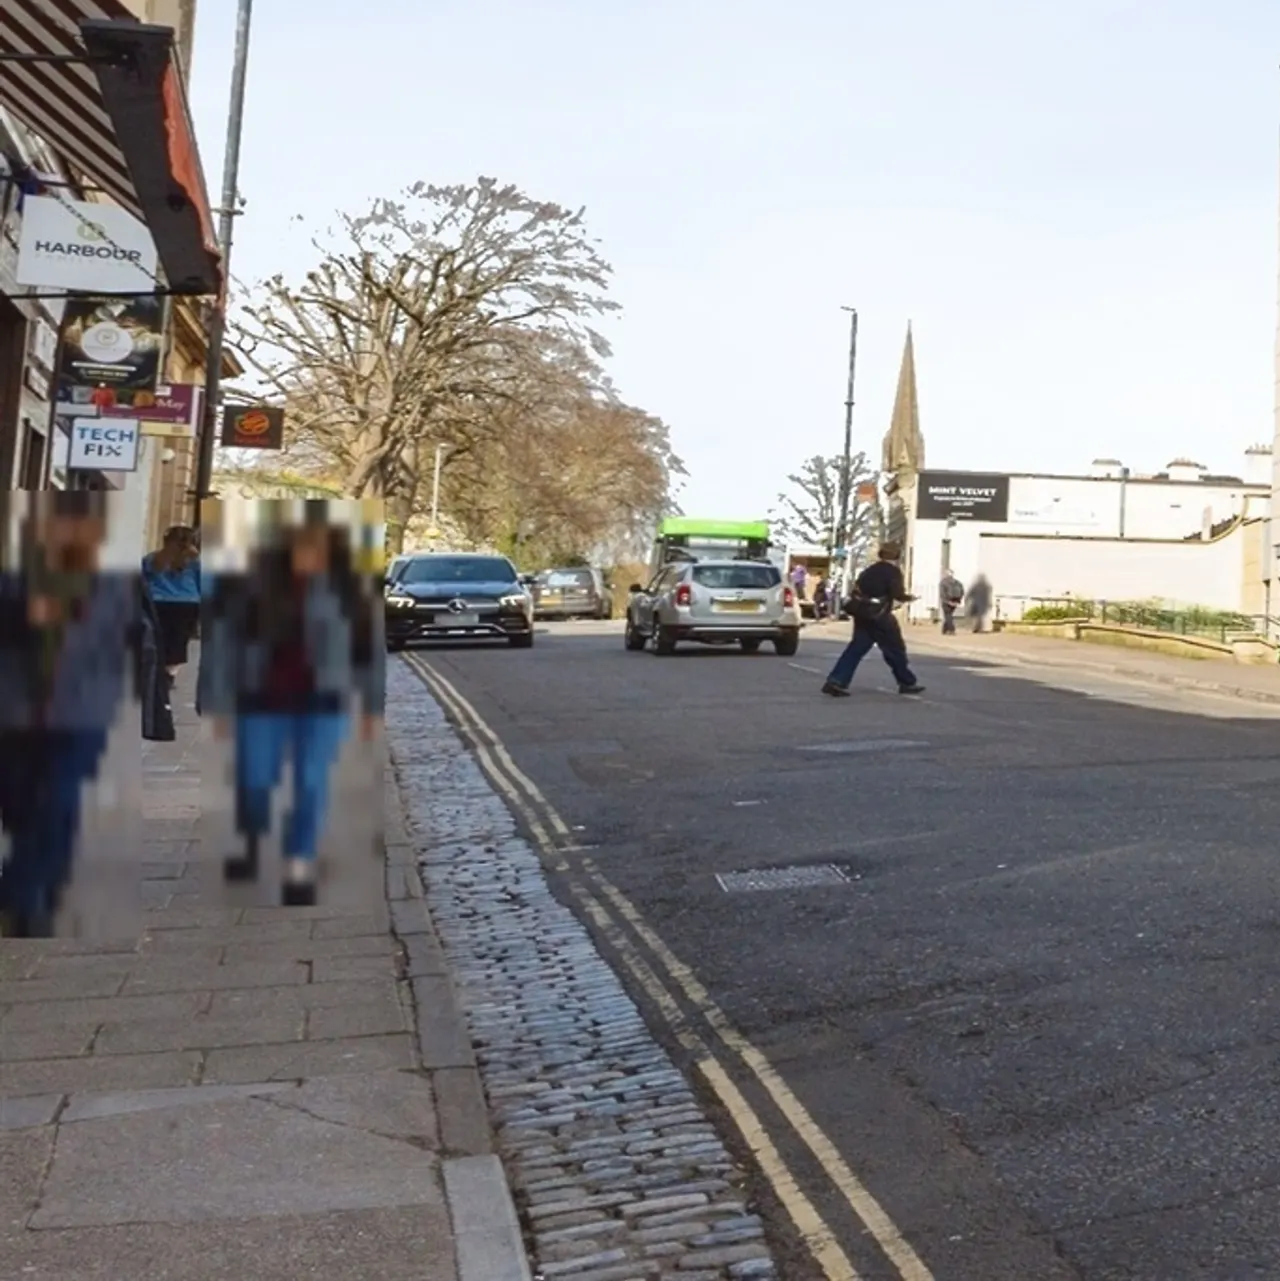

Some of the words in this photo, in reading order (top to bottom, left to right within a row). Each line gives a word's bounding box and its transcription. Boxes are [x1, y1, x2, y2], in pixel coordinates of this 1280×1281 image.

[35, 240, 142, 262] HARBOUR
[77, 427, 133, 442] TECH
[84, 444, 122, 457] FIX
[928, 486, 957, 495] MINT
[959, 487, 997, 496] VELVET
